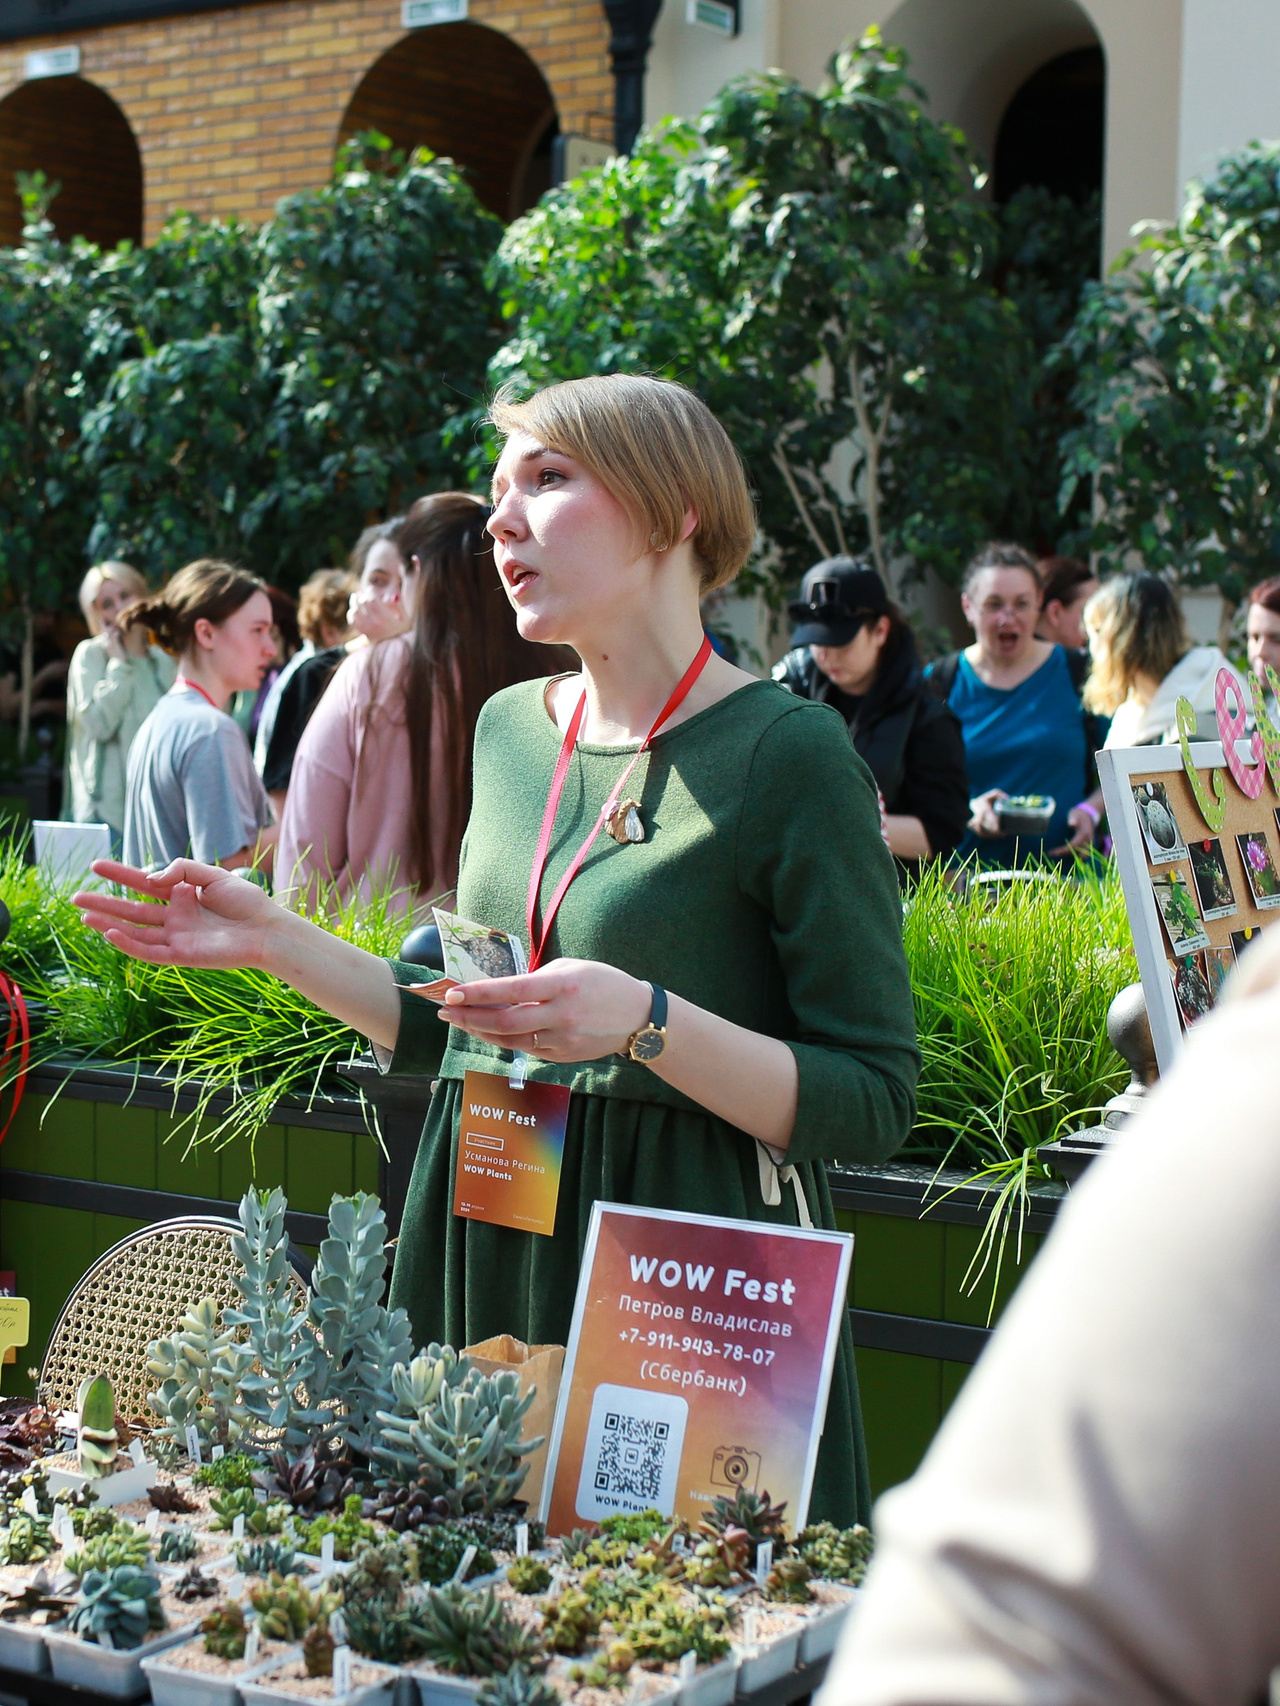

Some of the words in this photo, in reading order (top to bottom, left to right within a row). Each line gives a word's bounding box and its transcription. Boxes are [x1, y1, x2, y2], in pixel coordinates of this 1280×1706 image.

[469, 1103, 504, 1121] WOW
[508, 1110, 537, 1127] Fest
[463, 1163, 485, 1175] WOW
[486, 1168, 513, 1181] Plants
[464, 1150, 509, 1167] Усманова
[512, 1159, 546, 1174] Регина
[629, 1254, 715, 1293] WOW
[723, 1269, 797, 1306] Fest
[618, 1294, 685, 1320] Петров
[690, 1306, 793, 1338] Владислав
[619, 1327, 776, 1367] +7-911-943-78-07
[640, 1359, 747, 1397] (Сбербанк)
[595, 1494, 620, 1508] WOW
